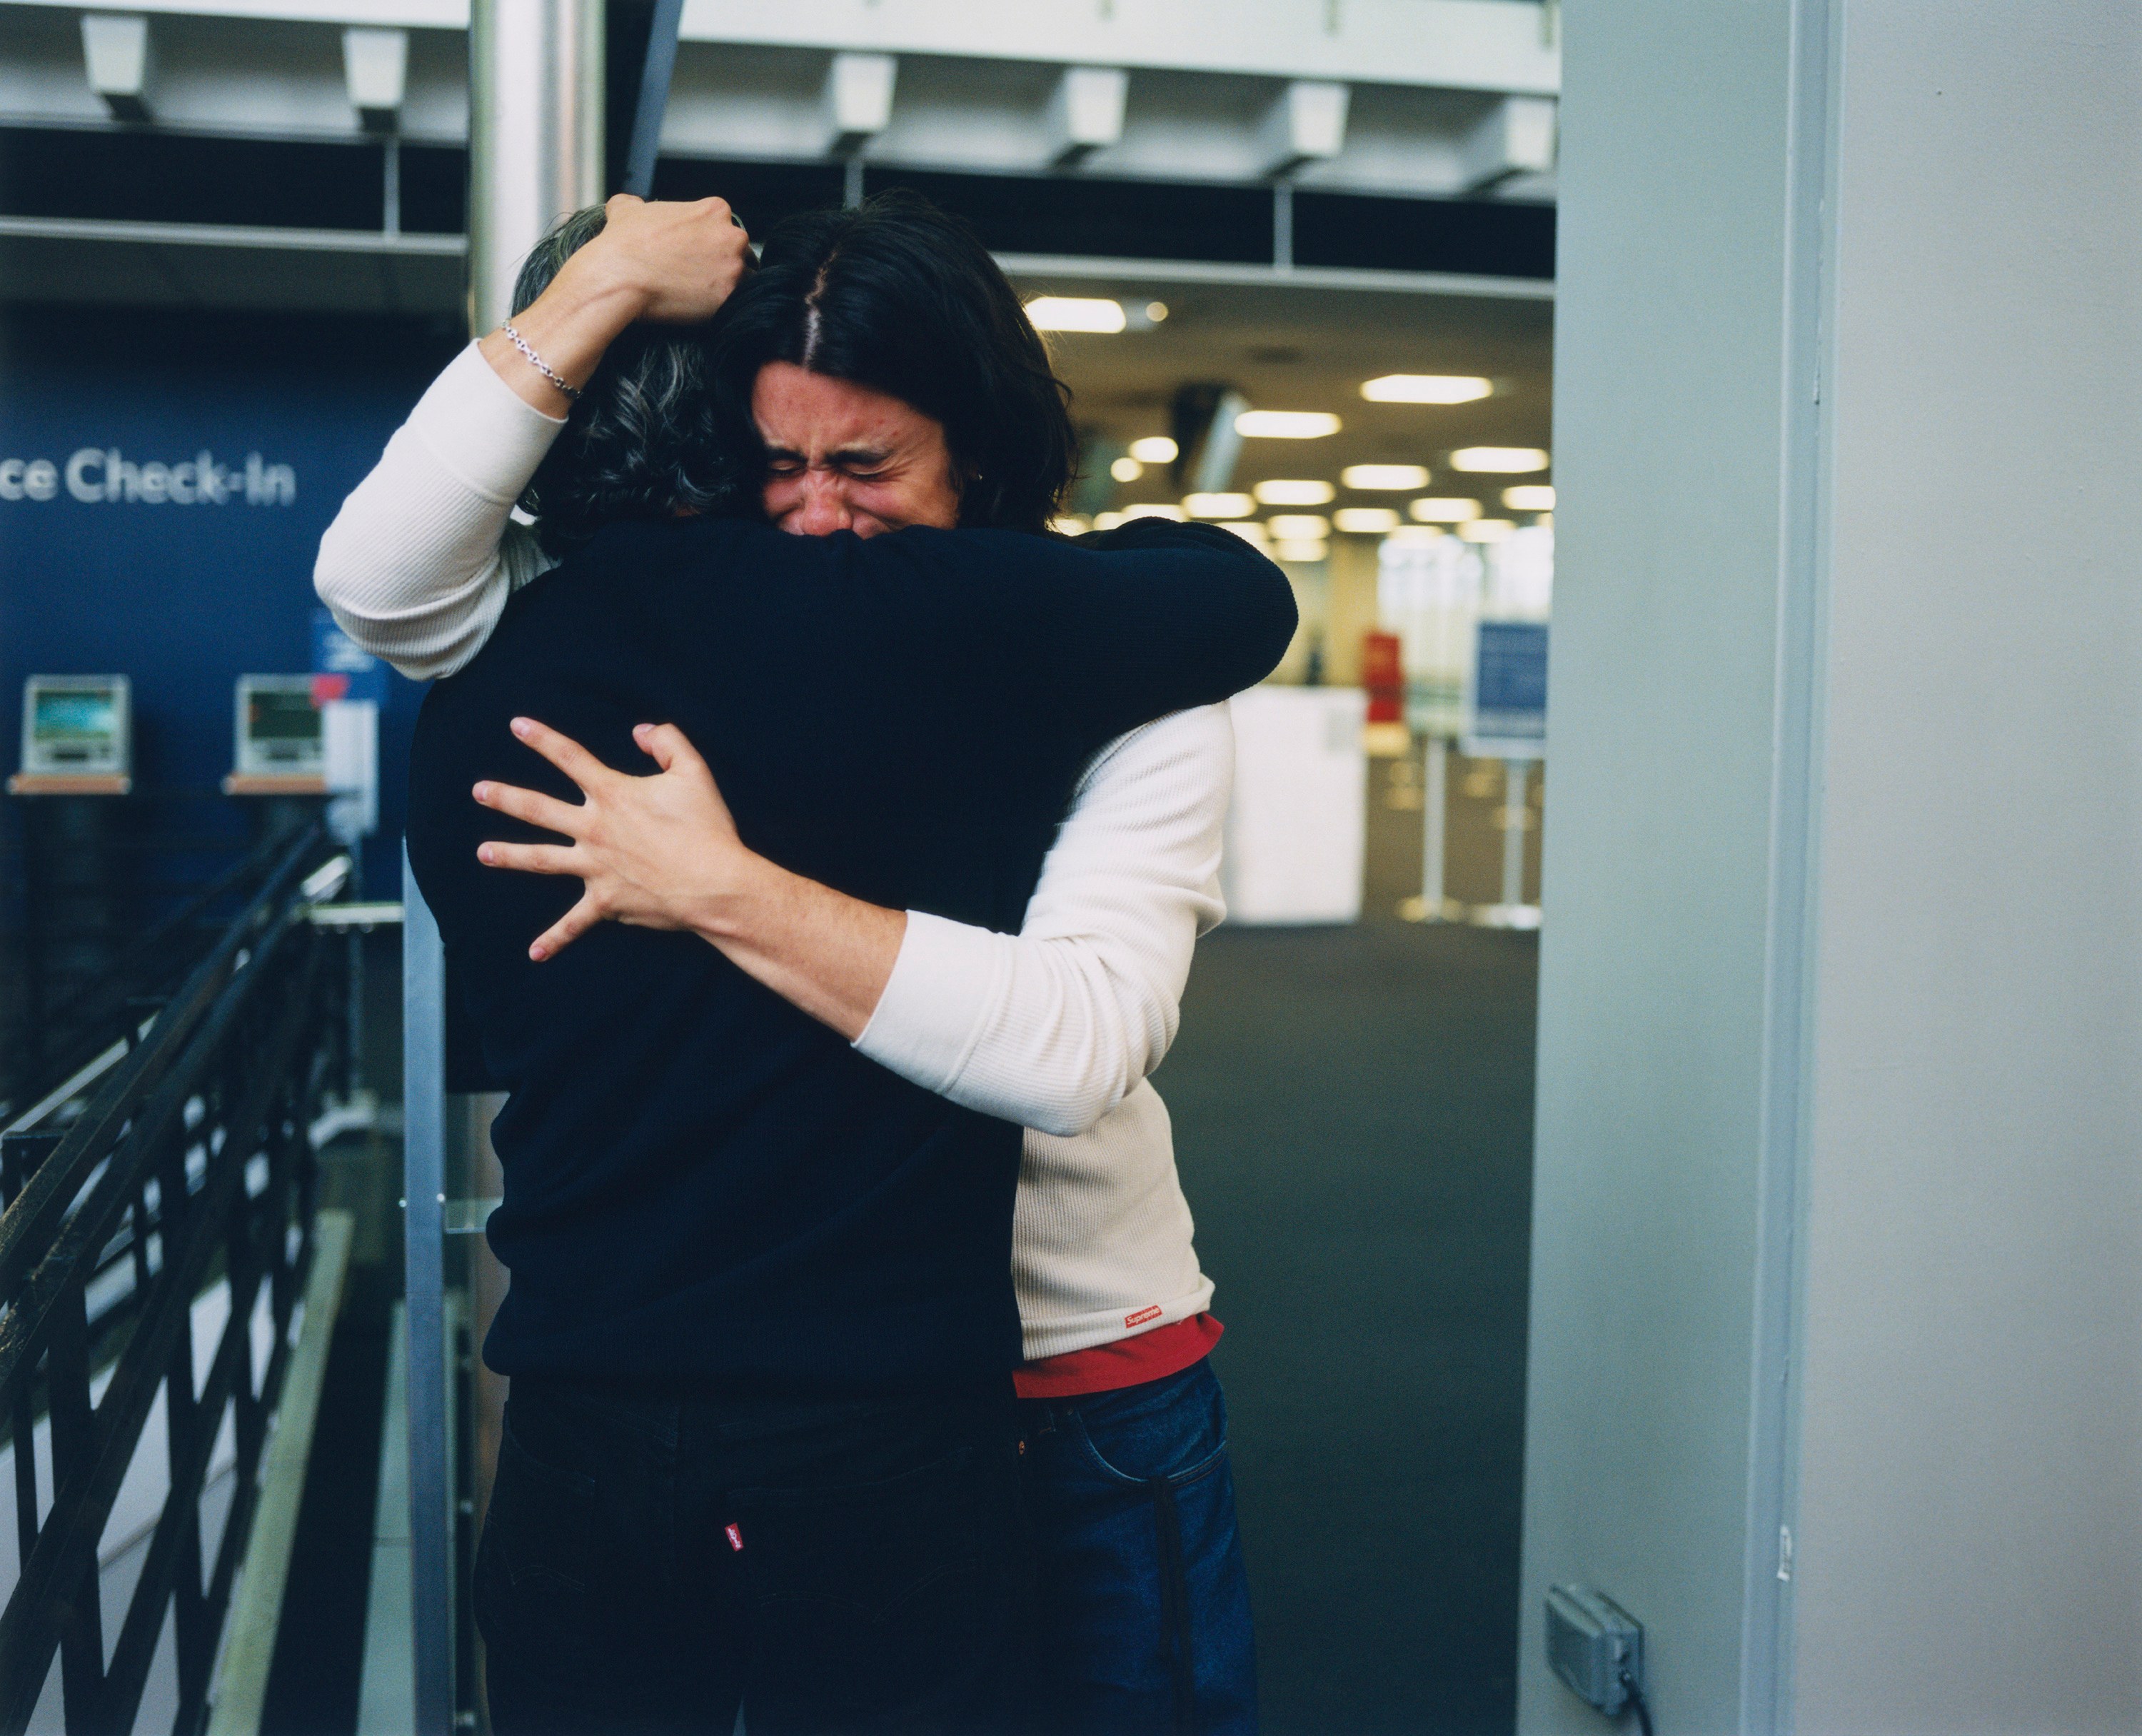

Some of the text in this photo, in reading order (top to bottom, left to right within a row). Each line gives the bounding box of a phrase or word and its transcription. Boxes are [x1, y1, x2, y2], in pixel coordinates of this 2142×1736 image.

[0, 448, 296, 506] ce Check-In
[1127, 1307, 1160, 1325] Supreme
